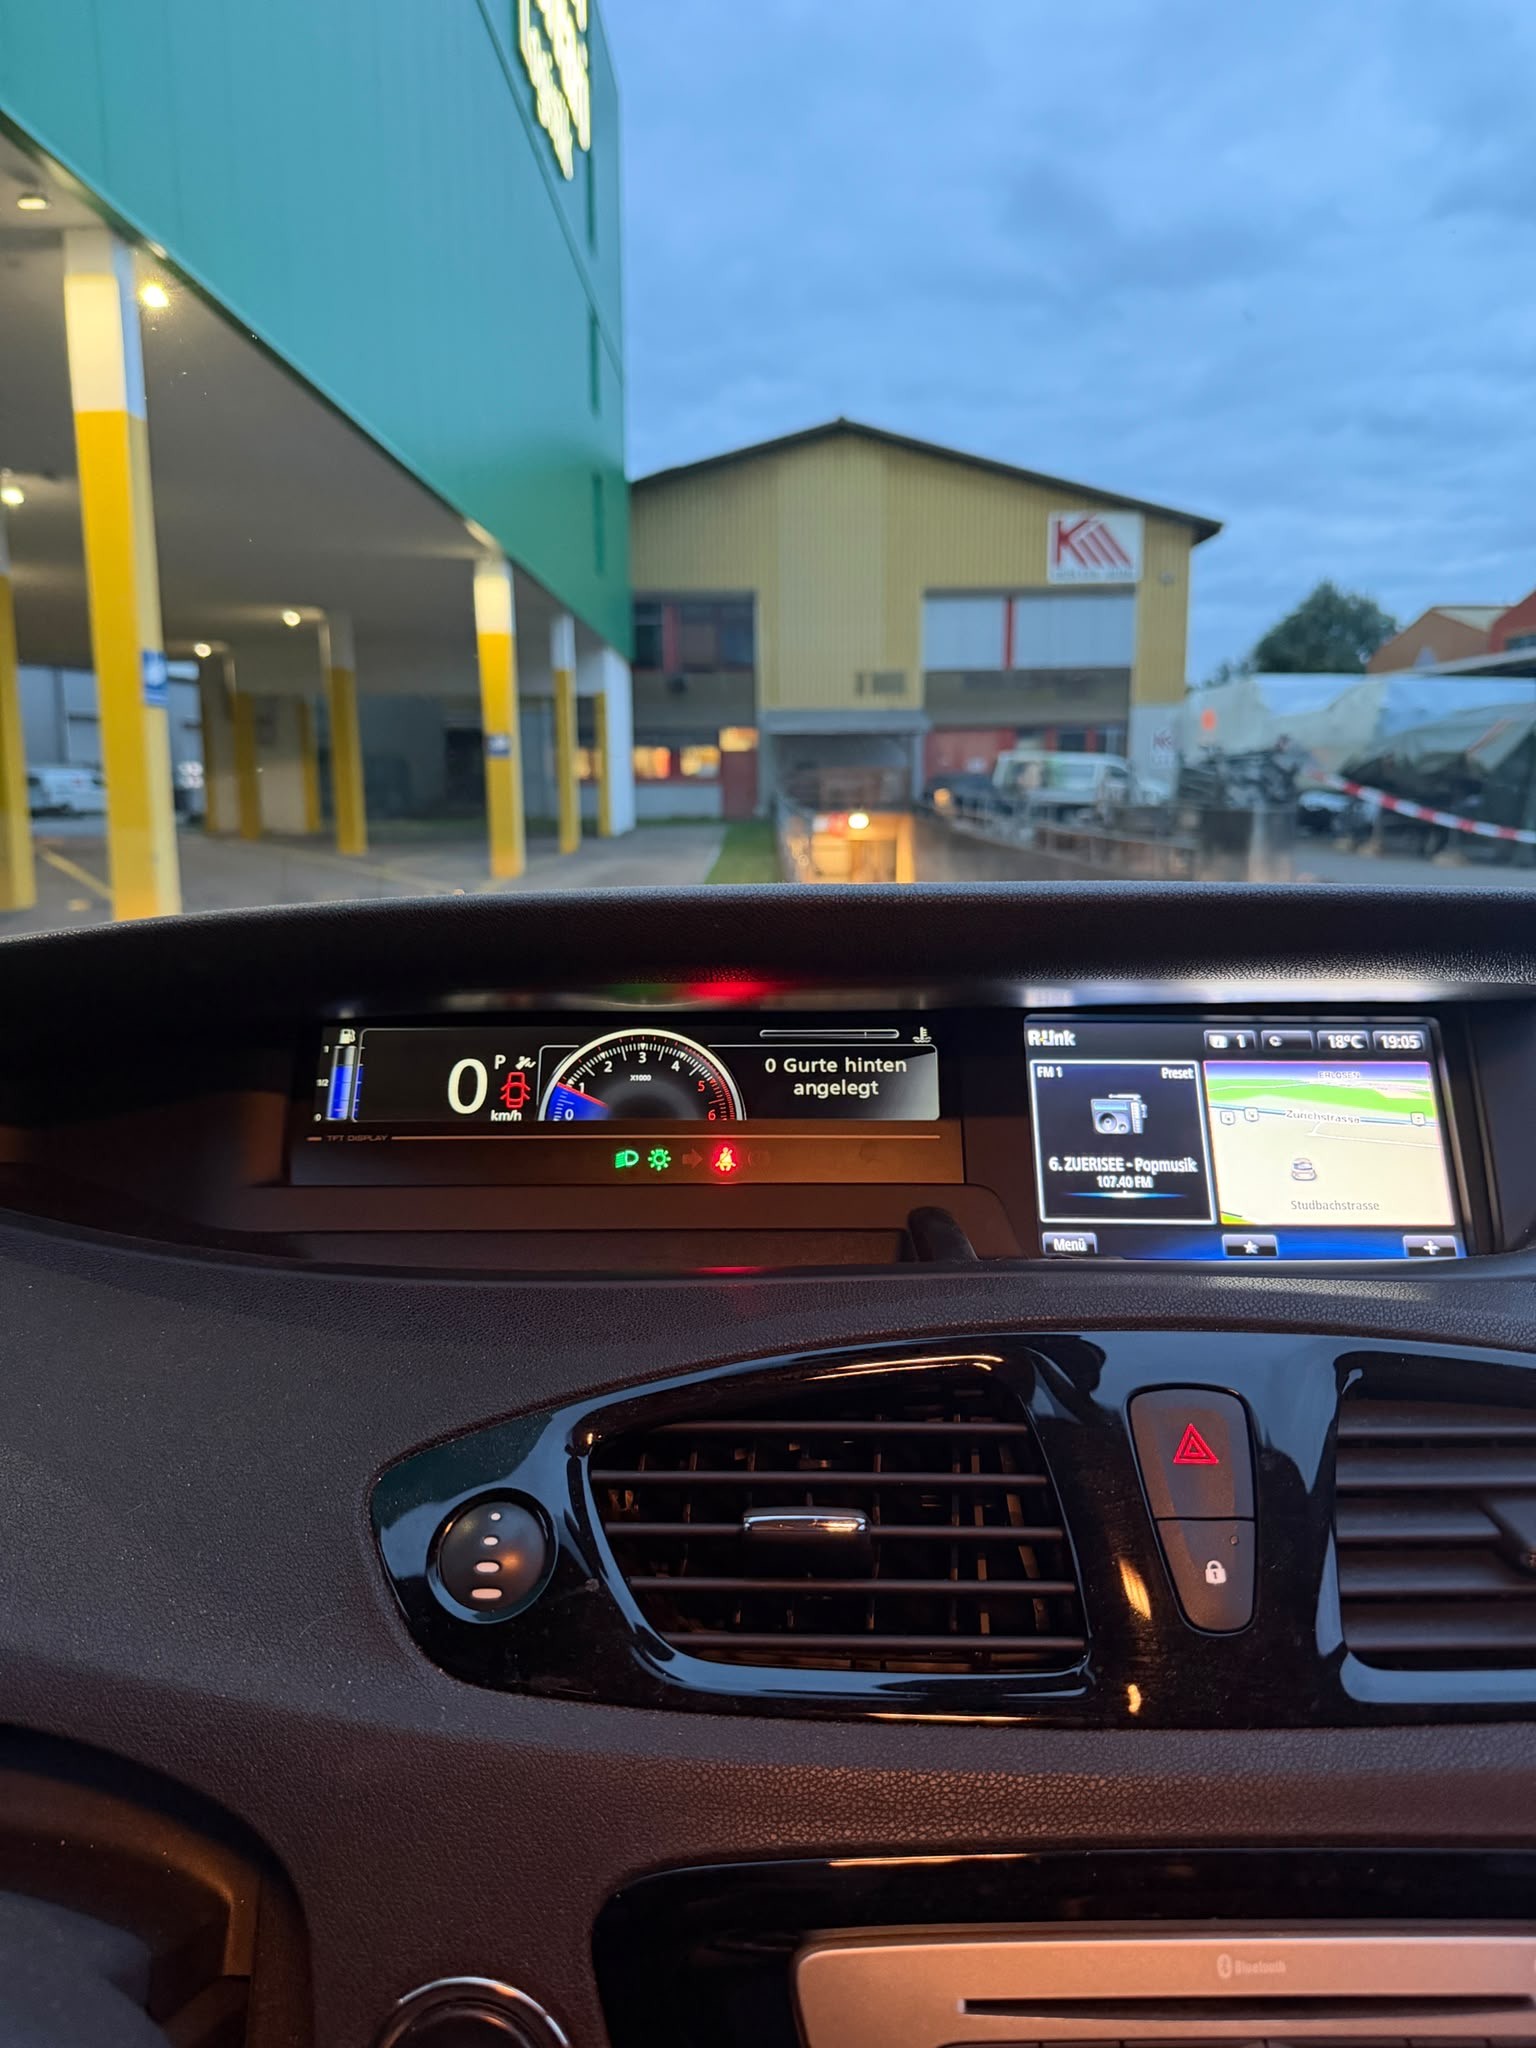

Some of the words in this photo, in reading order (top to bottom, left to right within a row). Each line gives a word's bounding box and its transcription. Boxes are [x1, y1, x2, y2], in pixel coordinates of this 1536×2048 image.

[1381, 1034, 1421, 1049] 19:05
[494, 1055, 506, 1069] P
[638, 1052, 647, 1063] 3
[604, 1061, 613, 1073] 2
[671, 1062, 680, 1072] 4
[764, 1058, 777, 1073] 0
[783, 1058, 838, 1073] Gurte
[845, 1057, 907, 1073] hinten
[1036, 1066, 1055, 1078] FM
[1056, 1066, 1063, 1078] 1
[1161, 1067, 1195, 1080] Preset
[447, 1058, 488, 1114] 0
[578, 1082, 585, 1094] 1
[697, 1080, 706, 1092] 5
[793, 1079, 879, 1098] angelegt
[490, 1110, 522, 1121] km/h
[565, 1109, 574, 1121] 0
[707, 1109, 716, 1121] 6
[1049, 1156, 1063, 1171] 6.
[1064, 1156, 1125, 1172] ZUERISEE
[1134, 1157, 1198, 1175] Popmusik
[1096, 1175, 1134, 1188] 107.40
[1134, 1176, 1154, 1188] FM
[1290, 1200, 1380, 1211] Studbachstrasse
[1053, 1237, 1087, 1252] Menü
[1234, 1959, 1287, 1975] Bluetooth
